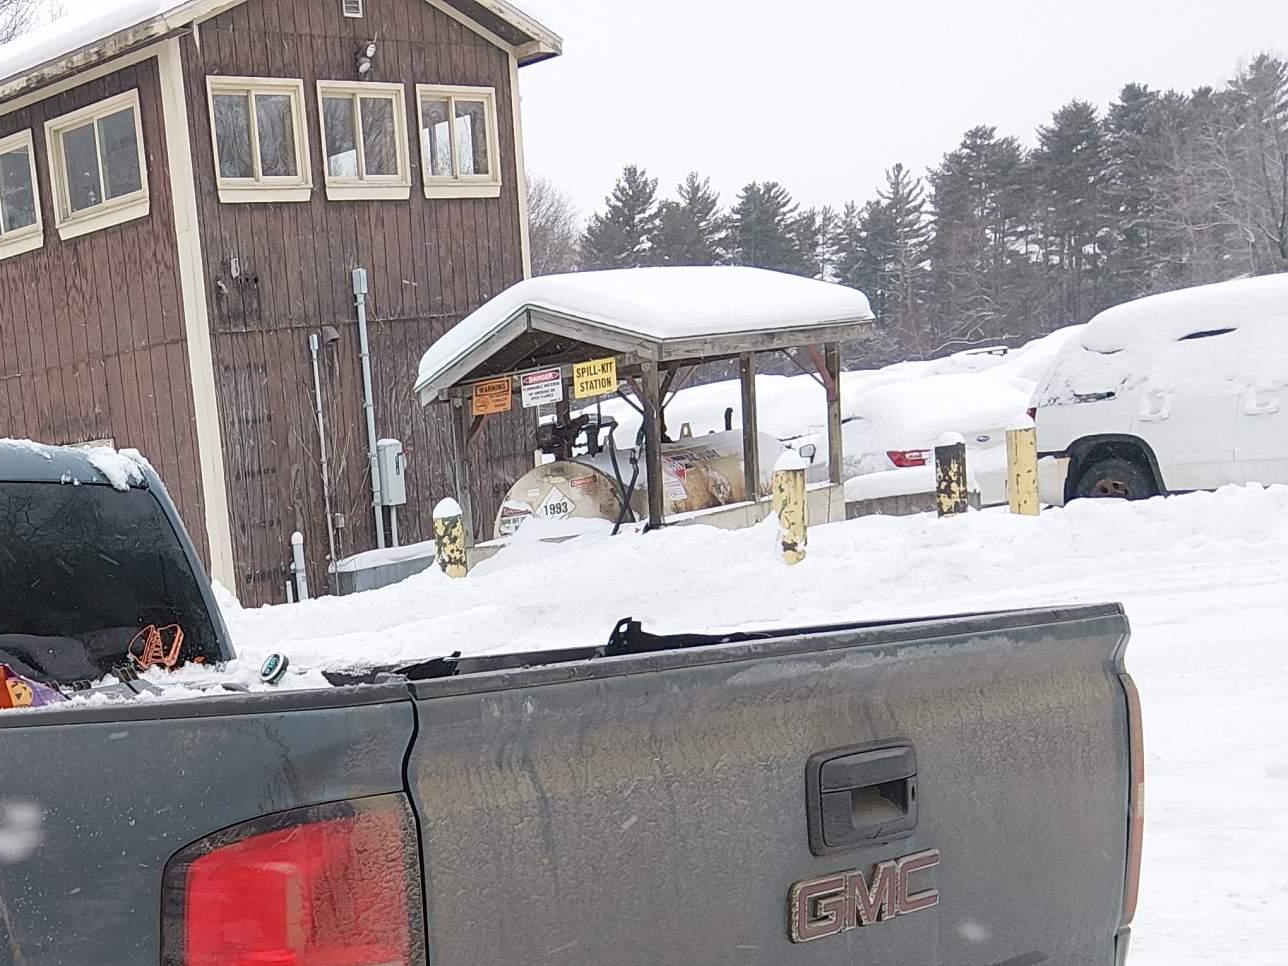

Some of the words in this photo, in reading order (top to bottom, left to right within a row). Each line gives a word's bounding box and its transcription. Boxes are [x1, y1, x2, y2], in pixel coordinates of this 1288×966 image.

[576, 361, 613, 378] SPILL-KIT
[528, 371, 553, 384] DANGER
[579, 377, 612, 392] STATION
[478, 383, 506, 394] WARNING
[544, 501, 568, 516] 1993
[788, 848, 941, 943] GMC
